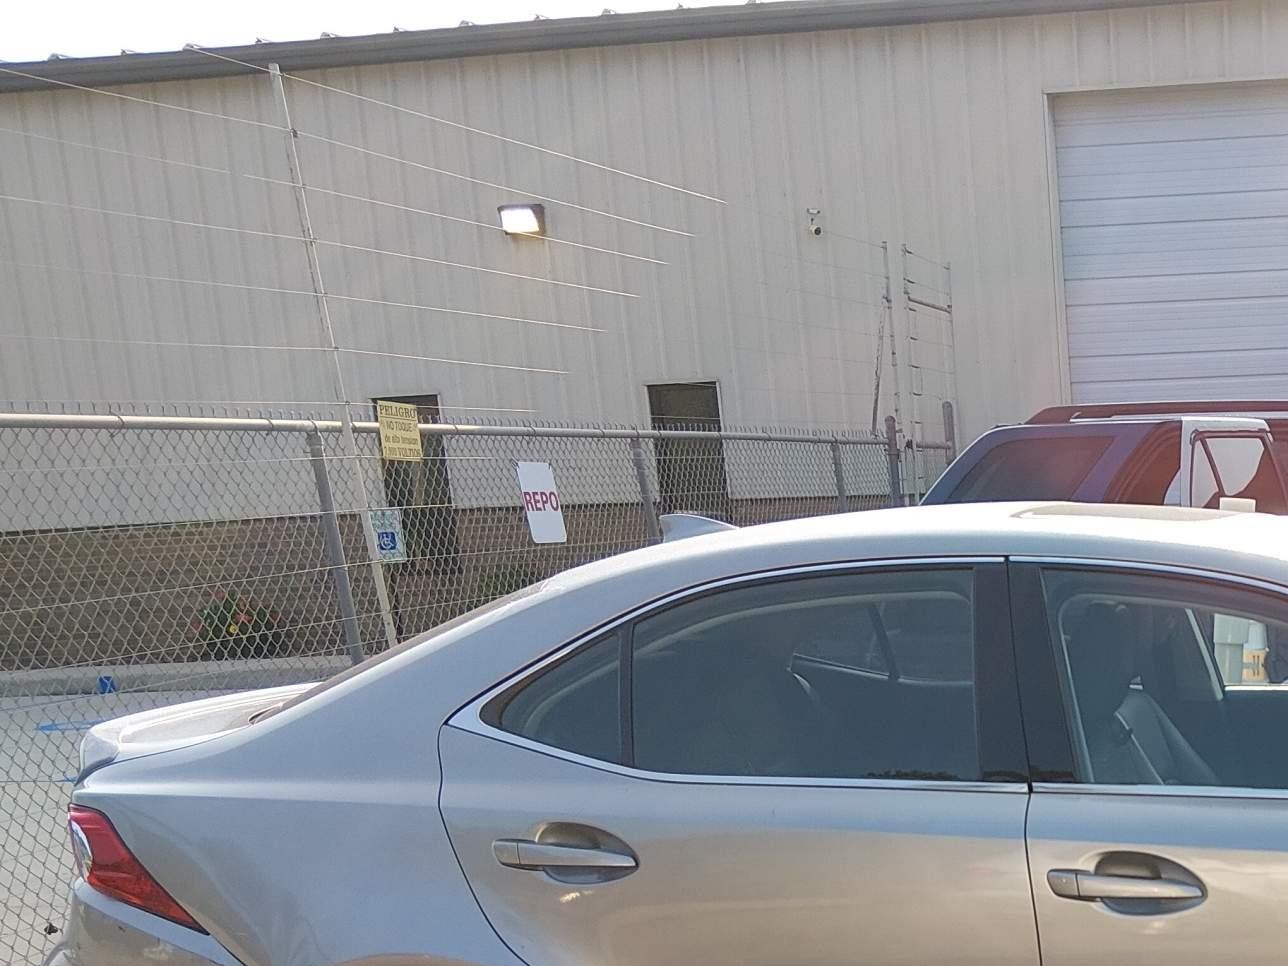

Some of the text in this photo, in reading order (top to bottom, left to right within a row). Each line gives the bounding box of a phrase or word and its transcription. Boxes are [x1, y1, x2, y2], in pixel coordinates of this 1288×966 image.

[379, 404, 417, 418] PELIGRO
[386, 421, 394, 431] NO
[523, 491, 560, 512] REPO
